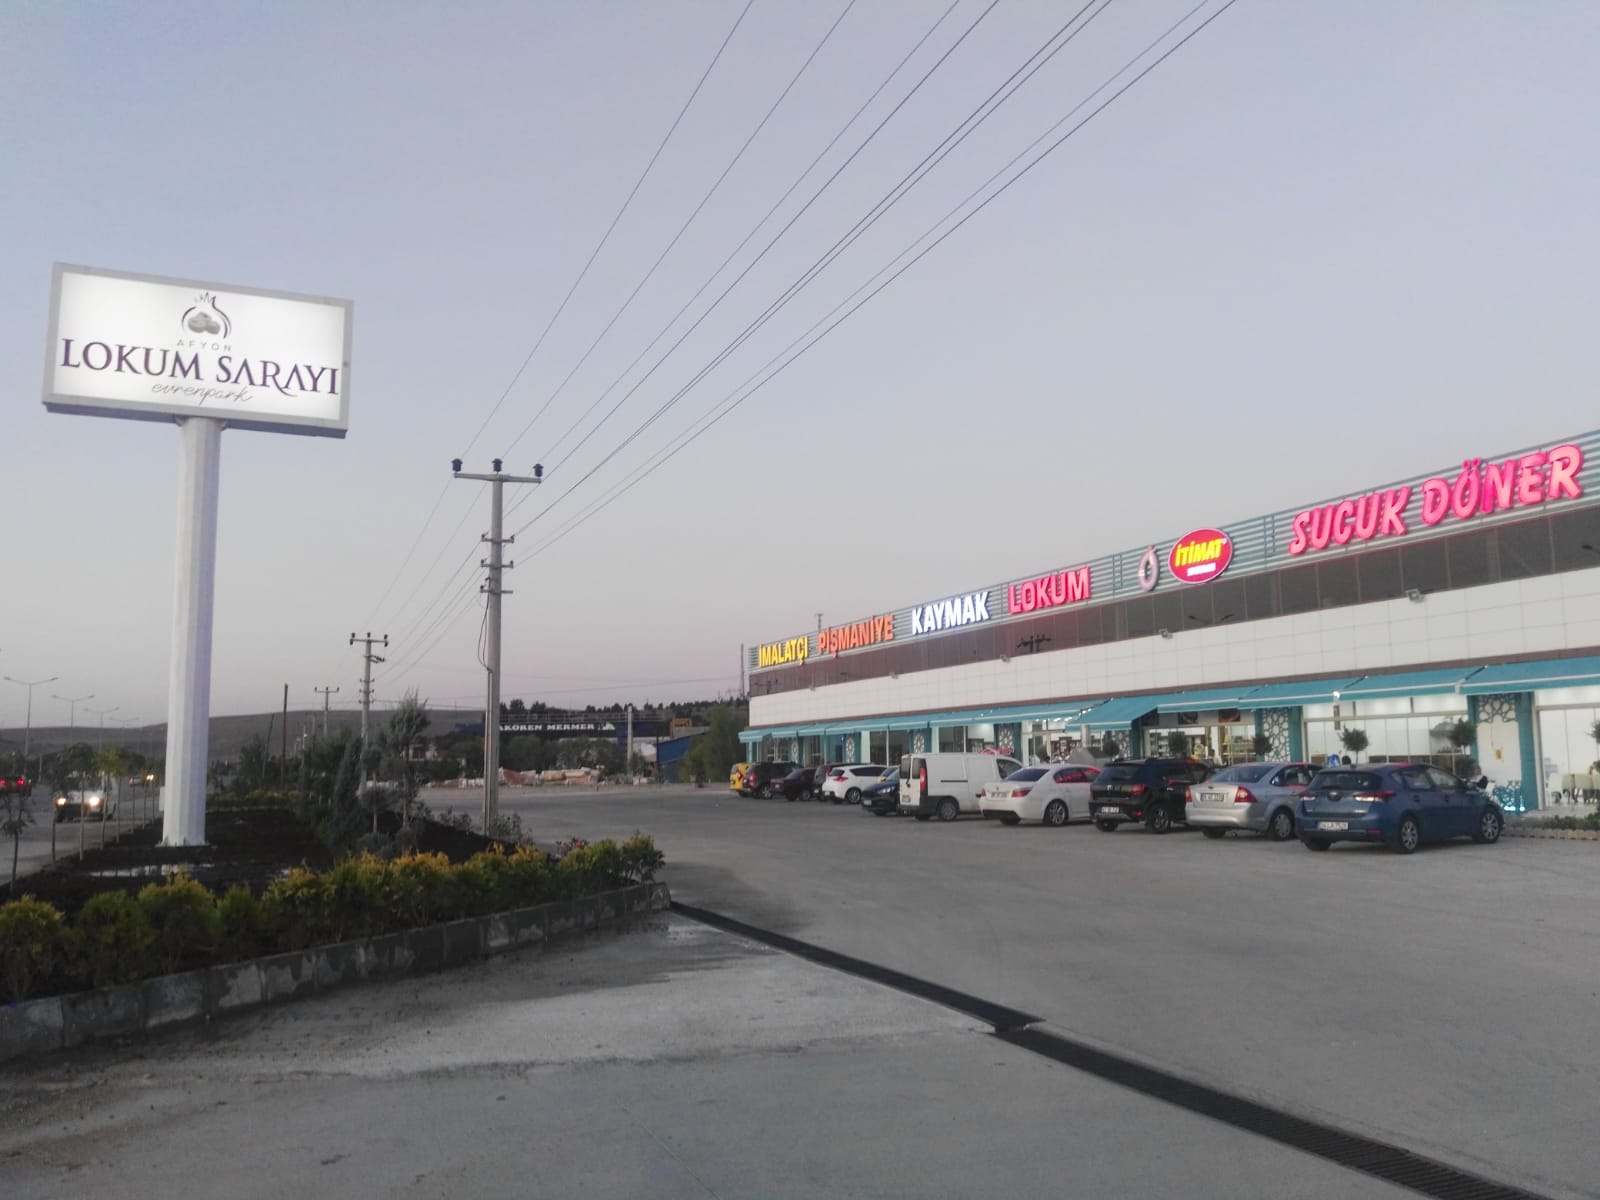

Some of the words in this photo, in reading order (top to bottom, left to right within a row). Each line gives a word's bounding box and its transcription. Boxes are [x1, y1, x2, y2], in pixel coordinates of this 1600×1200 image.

[176, 339, 232, 352] AFYON
[61, 338, 204, 381] LOKUM
[215, 355, 340, 398] SARAYI
[151, 383, 254, 406] evrenpark
[1288, 485, 1412, 555] SUCUK
[1421, 444, 1583, 527] DÖNER
[1175, 538, 1223, 567] İTİMAT
[1007, 566, 1092, 615] LOKUM
[911, 591, 991, 635] KAYMAK
[758, 636, 810, 667] İMALATÇI
[817, 613, 896, 659] PİŞMANİYE
[546, 723, 595, 731] MERMER
